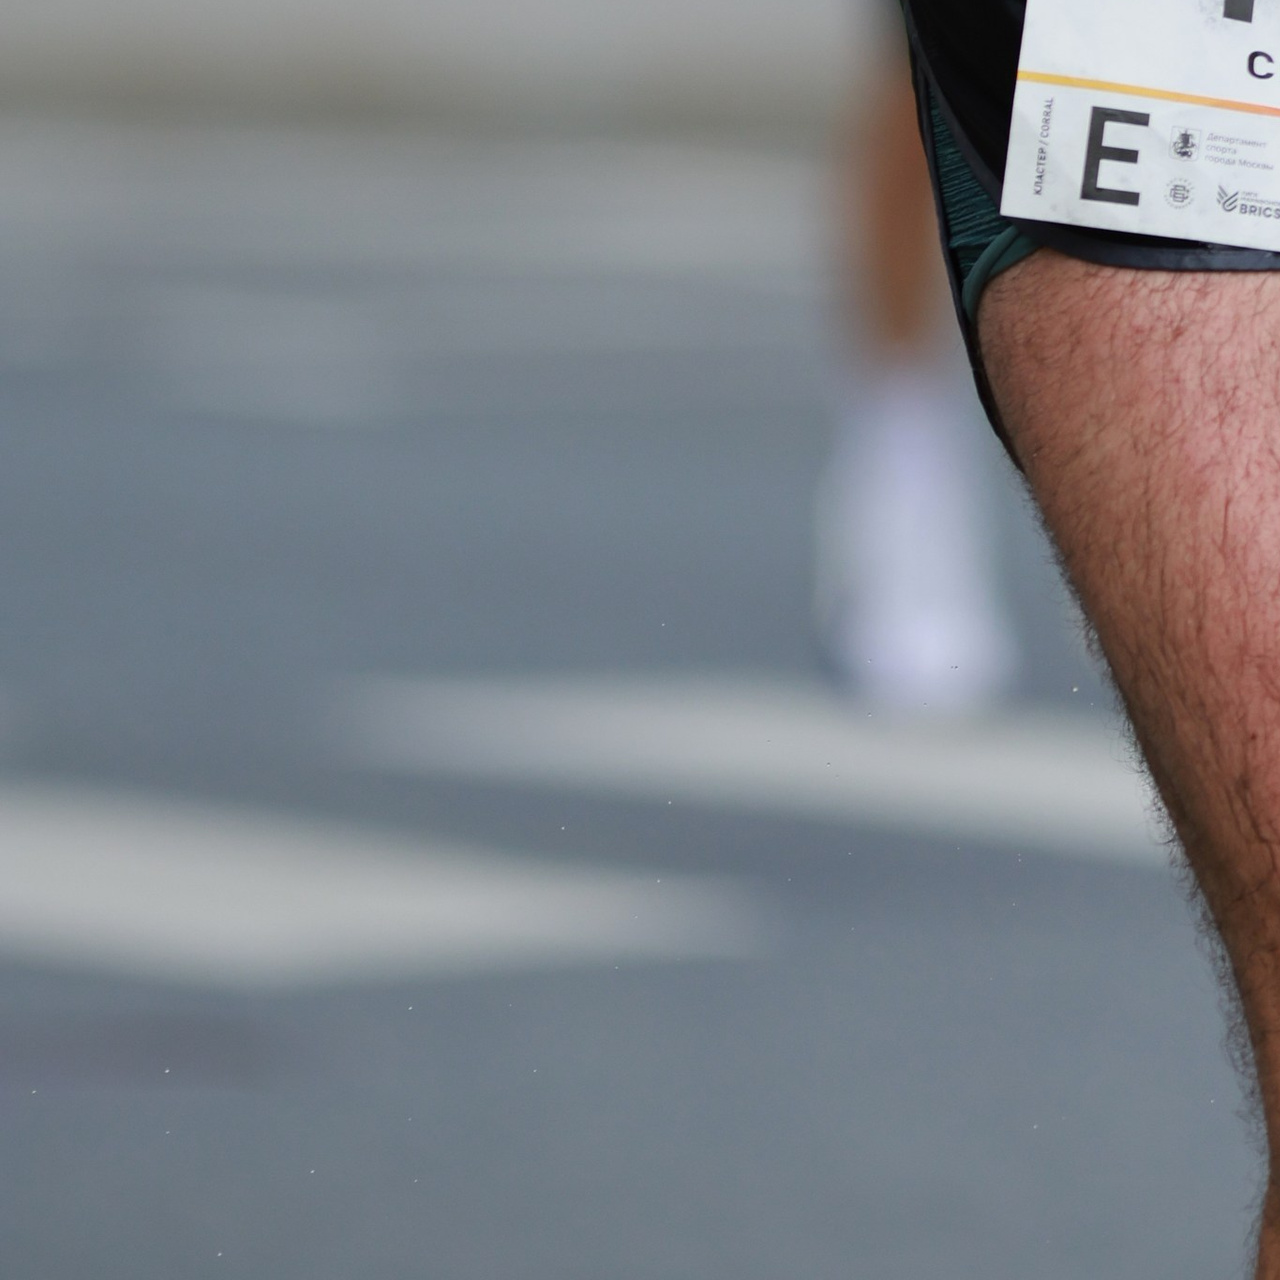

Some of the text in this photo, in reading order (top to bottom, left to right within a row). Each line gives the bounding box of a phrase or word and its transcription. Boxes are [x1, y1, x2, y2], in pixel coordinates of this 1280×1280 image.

[1033, 147, 1047, 196] КЛАСТЕР
[1040, 96, 1054, 139] CORRAL
[1080, 105, 1151, 207] E
